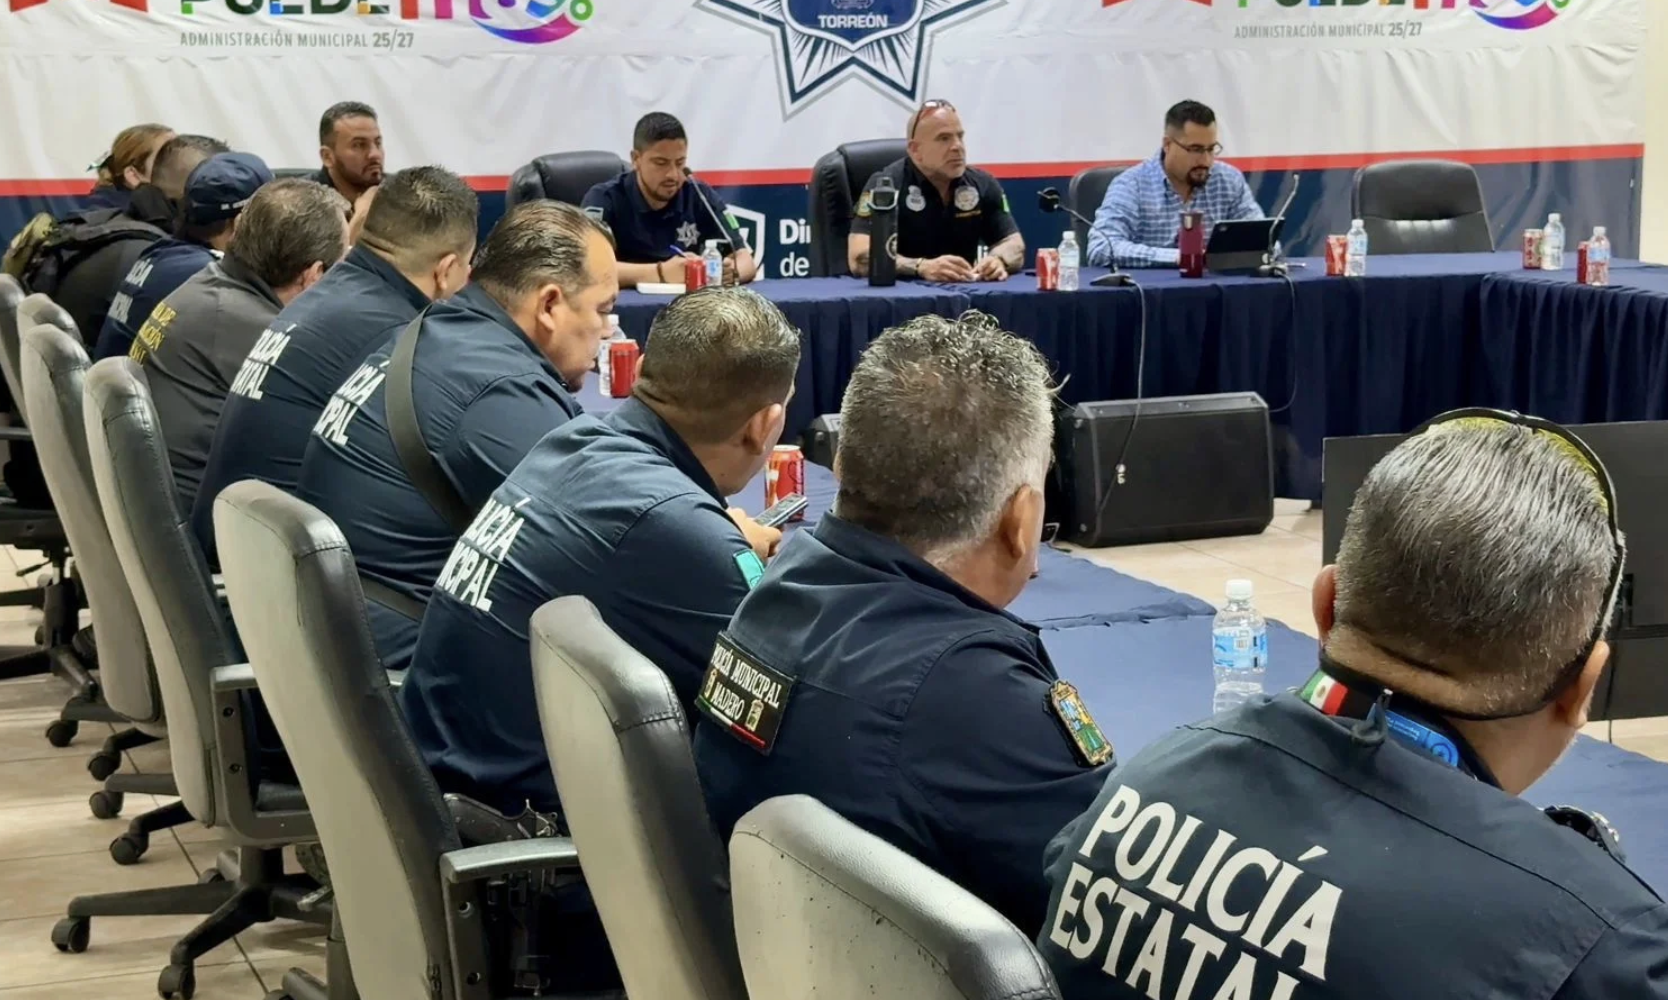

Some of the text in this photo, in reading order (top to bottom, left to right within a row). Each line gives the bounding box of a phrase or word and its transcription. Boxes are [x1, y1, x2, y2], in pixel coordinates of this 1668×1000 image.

[180, 29, 414, 50] ADMINISTRACIÓN MUNICIPAL 25/27
[817, 12, 888, 29] TORREÓN
[1234, 20, 1422, 39] ADMINISTRACIÓN MUNICIPAL 25/27
[780, 251, 810, 276] de
[461, 497, 531, 563] LICÍA
[434, 540, 499, 612] ICIPAL
[710, 681, 746, 721] MADERO
[730, 658, 783, 709] MUNICIPAL
[1078, 784, 1344, 981] POLICÍA
